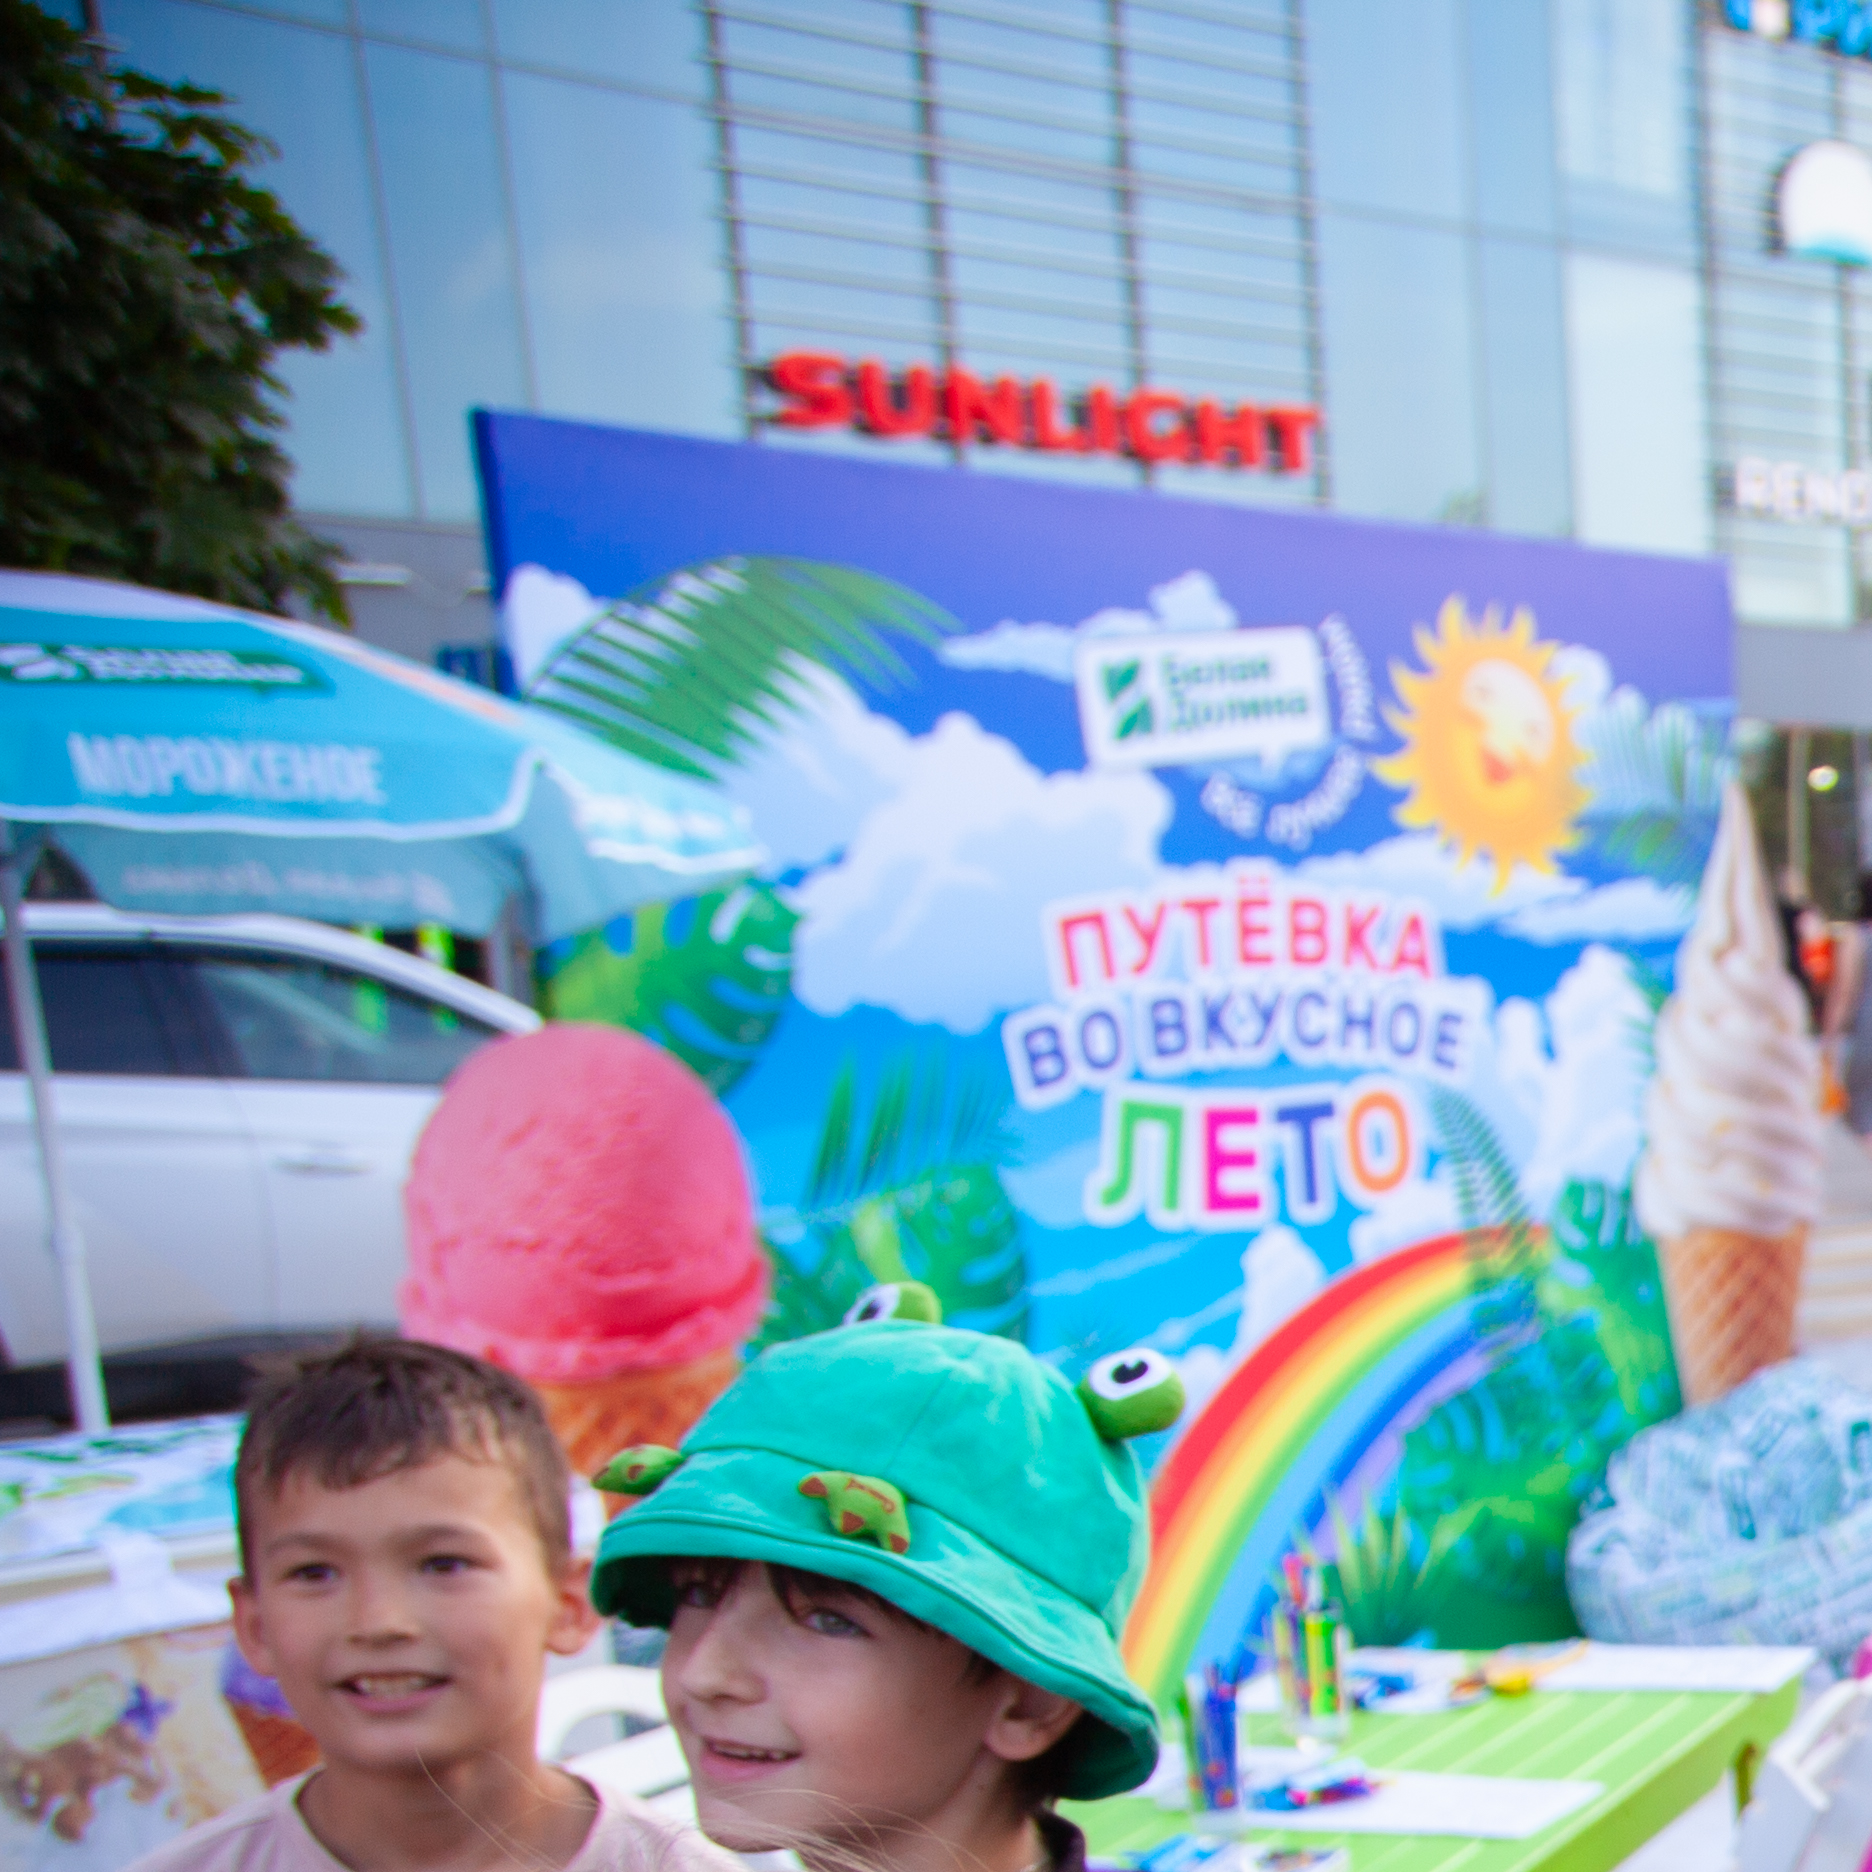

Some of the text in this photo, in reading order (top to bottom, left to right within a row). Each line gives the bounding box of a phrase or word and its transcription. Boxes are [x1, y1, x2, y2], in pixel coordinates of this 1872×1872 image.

[768, 350, 1318, 476] SUNLIGHT
[66, 731, 386, 804] МОРОЖЕНОЕ
[1058, 875, 1433, 989] ПУТЁВКА
[1020, 991, 1466, 1090] ВО ВКУСНОЕ
[1100, 1090, 1412, 1212] ЛЕТО
